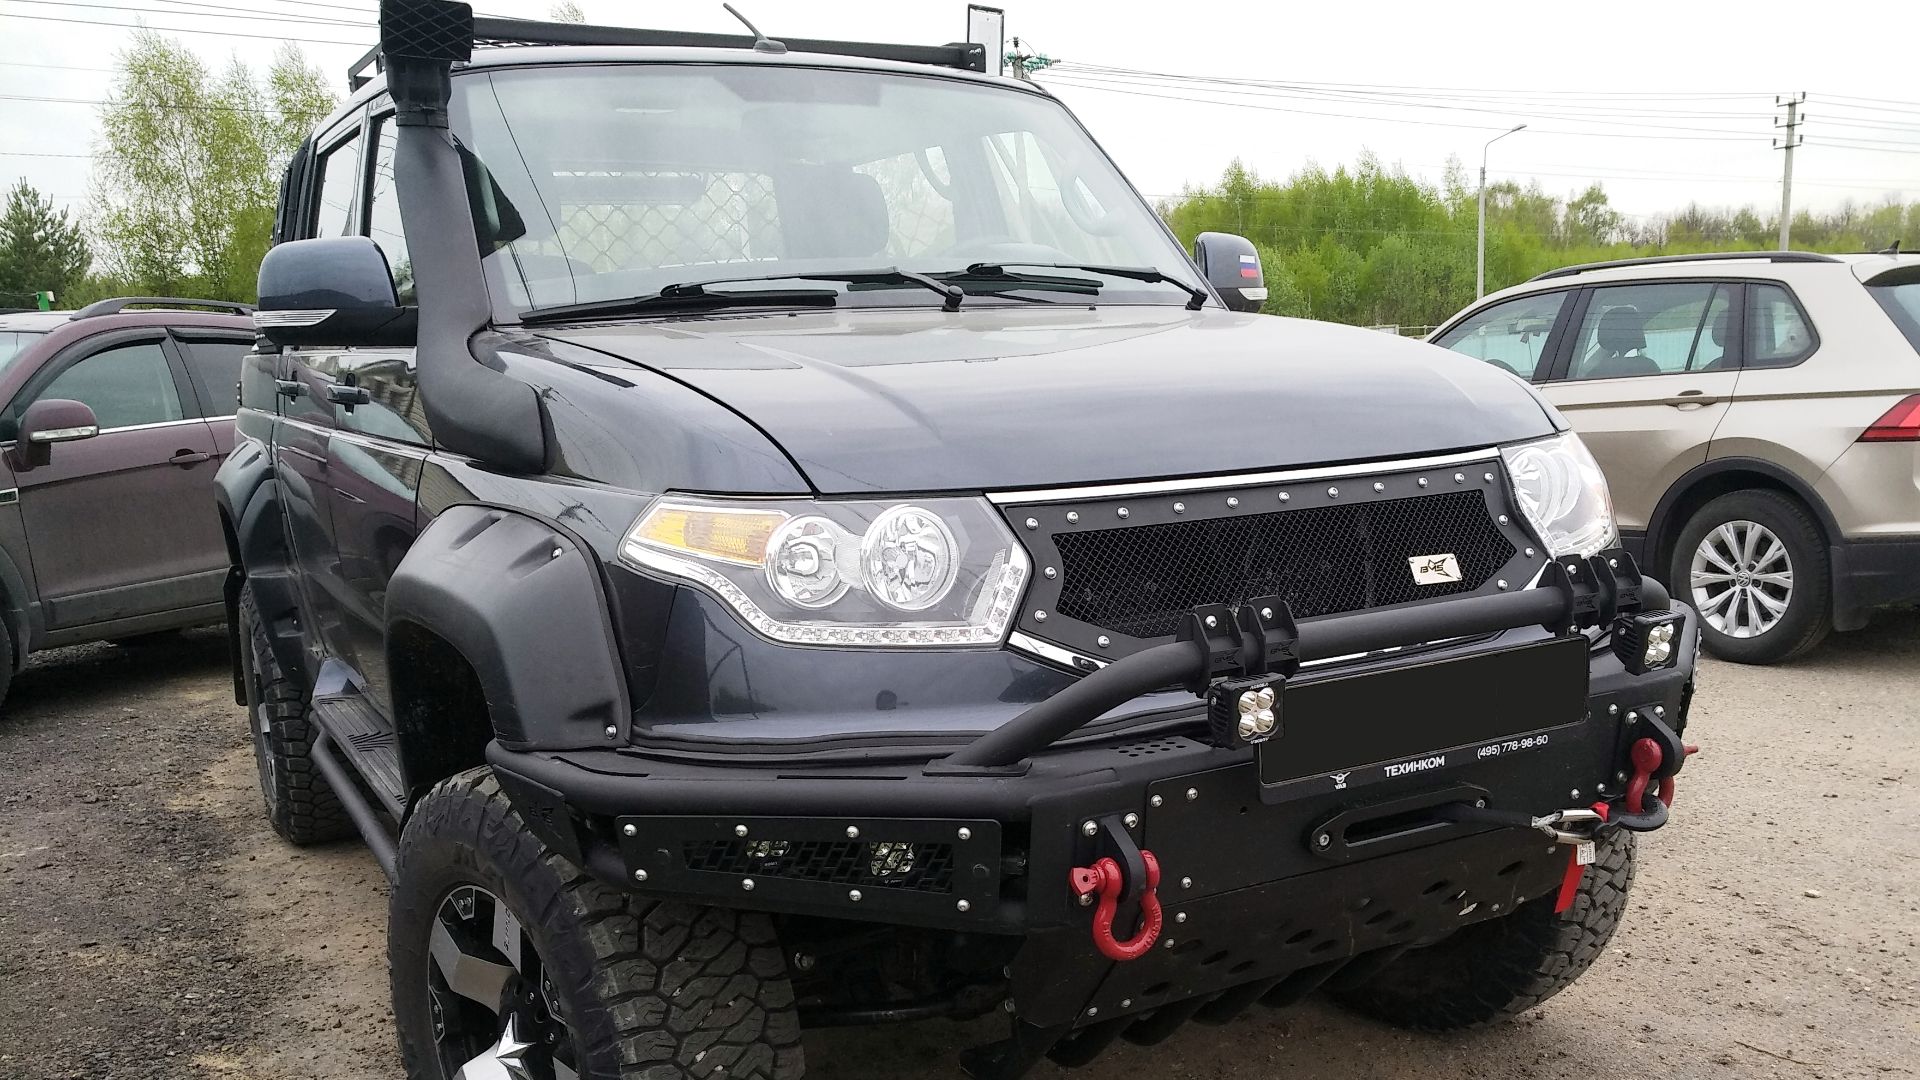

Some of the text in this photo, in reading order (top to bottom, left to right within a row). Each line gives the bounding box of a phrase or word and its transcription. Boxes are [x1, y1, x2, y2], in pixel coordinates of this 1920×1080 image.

[1477, 734, 1549, 760] (495) 778-98-60
[1383, 755, 1445, 778] ТЕХИНКОМ
